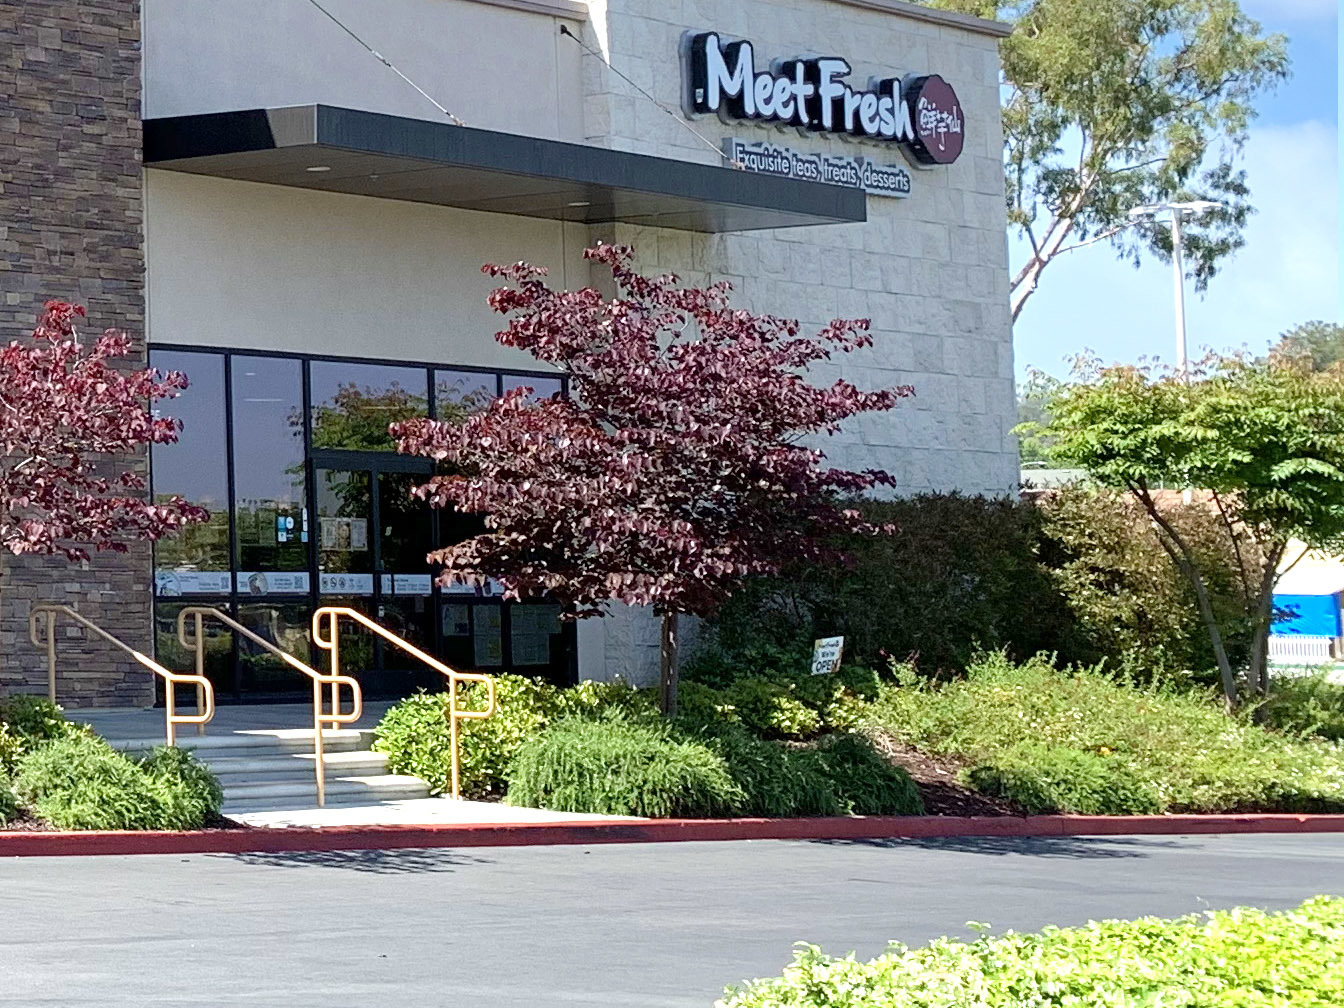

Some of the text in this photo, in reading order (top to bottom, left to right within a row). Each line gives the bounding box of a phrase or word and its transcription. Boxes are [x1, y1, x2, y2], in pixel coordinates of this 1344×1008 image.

[705, 34, 915, 143] Meet Fresh
[736, 146, 910, 192] Exquisite teas, treats, desserts
